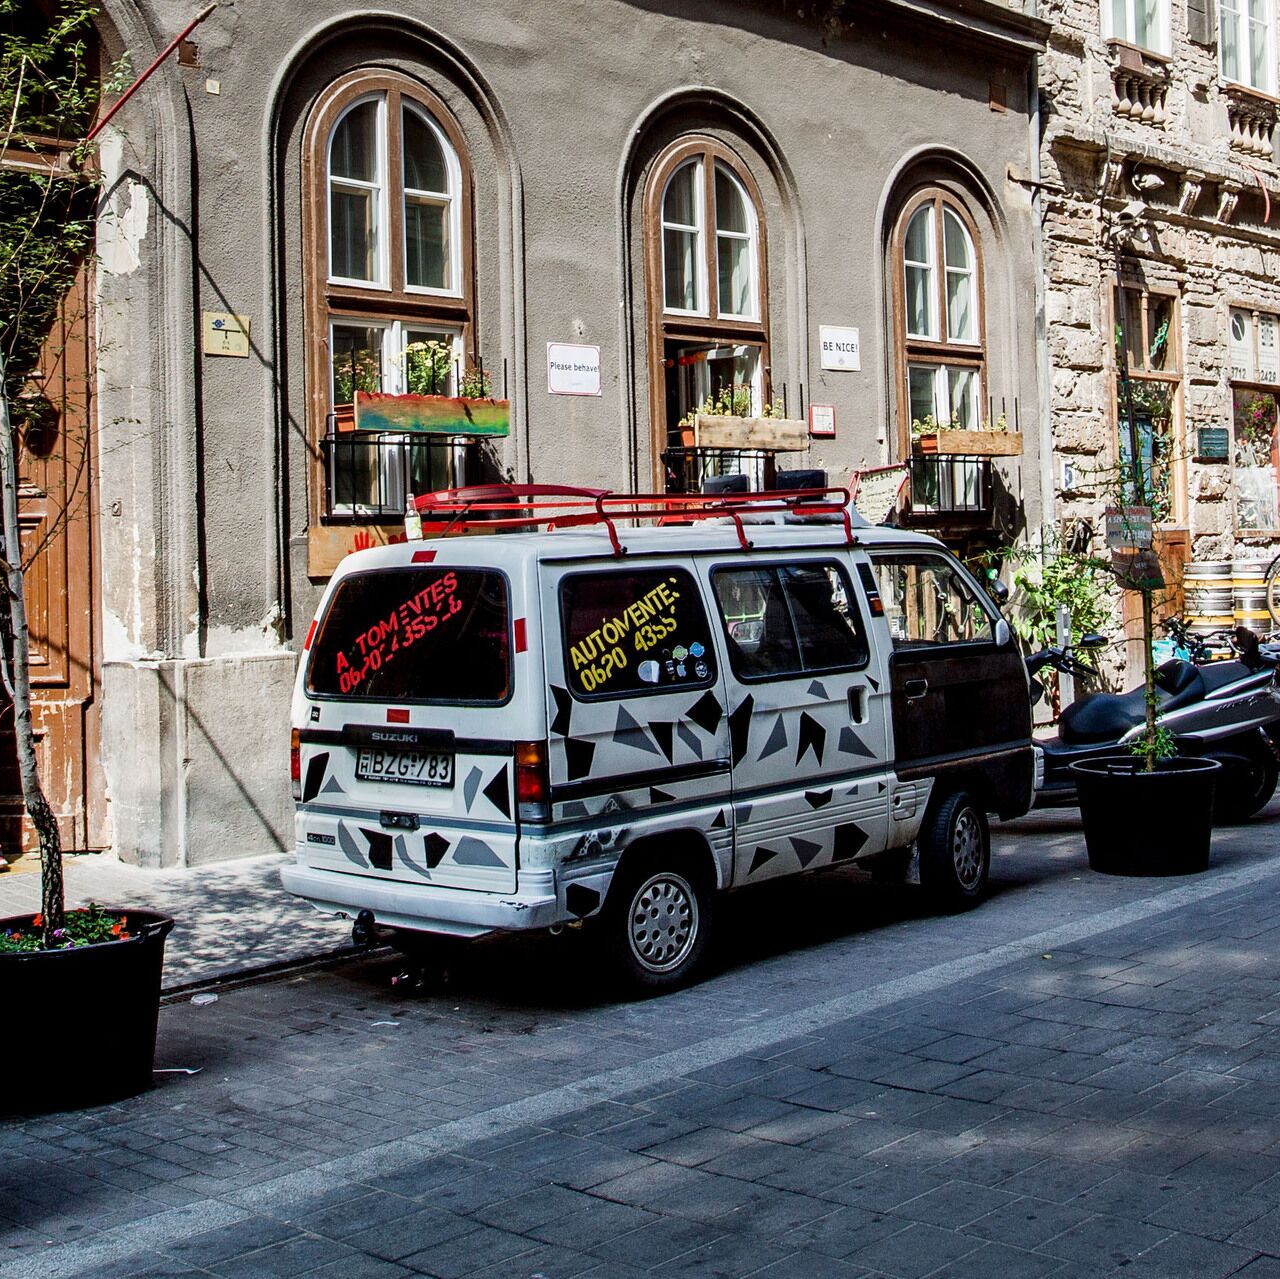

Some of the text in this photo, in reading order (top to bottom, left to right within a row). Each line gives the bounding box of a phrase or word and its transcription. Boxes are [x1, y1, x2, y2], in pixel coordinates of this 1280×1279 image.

[823, 341, 858, 353] BE NICE!
[550, 361, 572, 371] Please
[371, 731, 419, 743] SUZUKI
